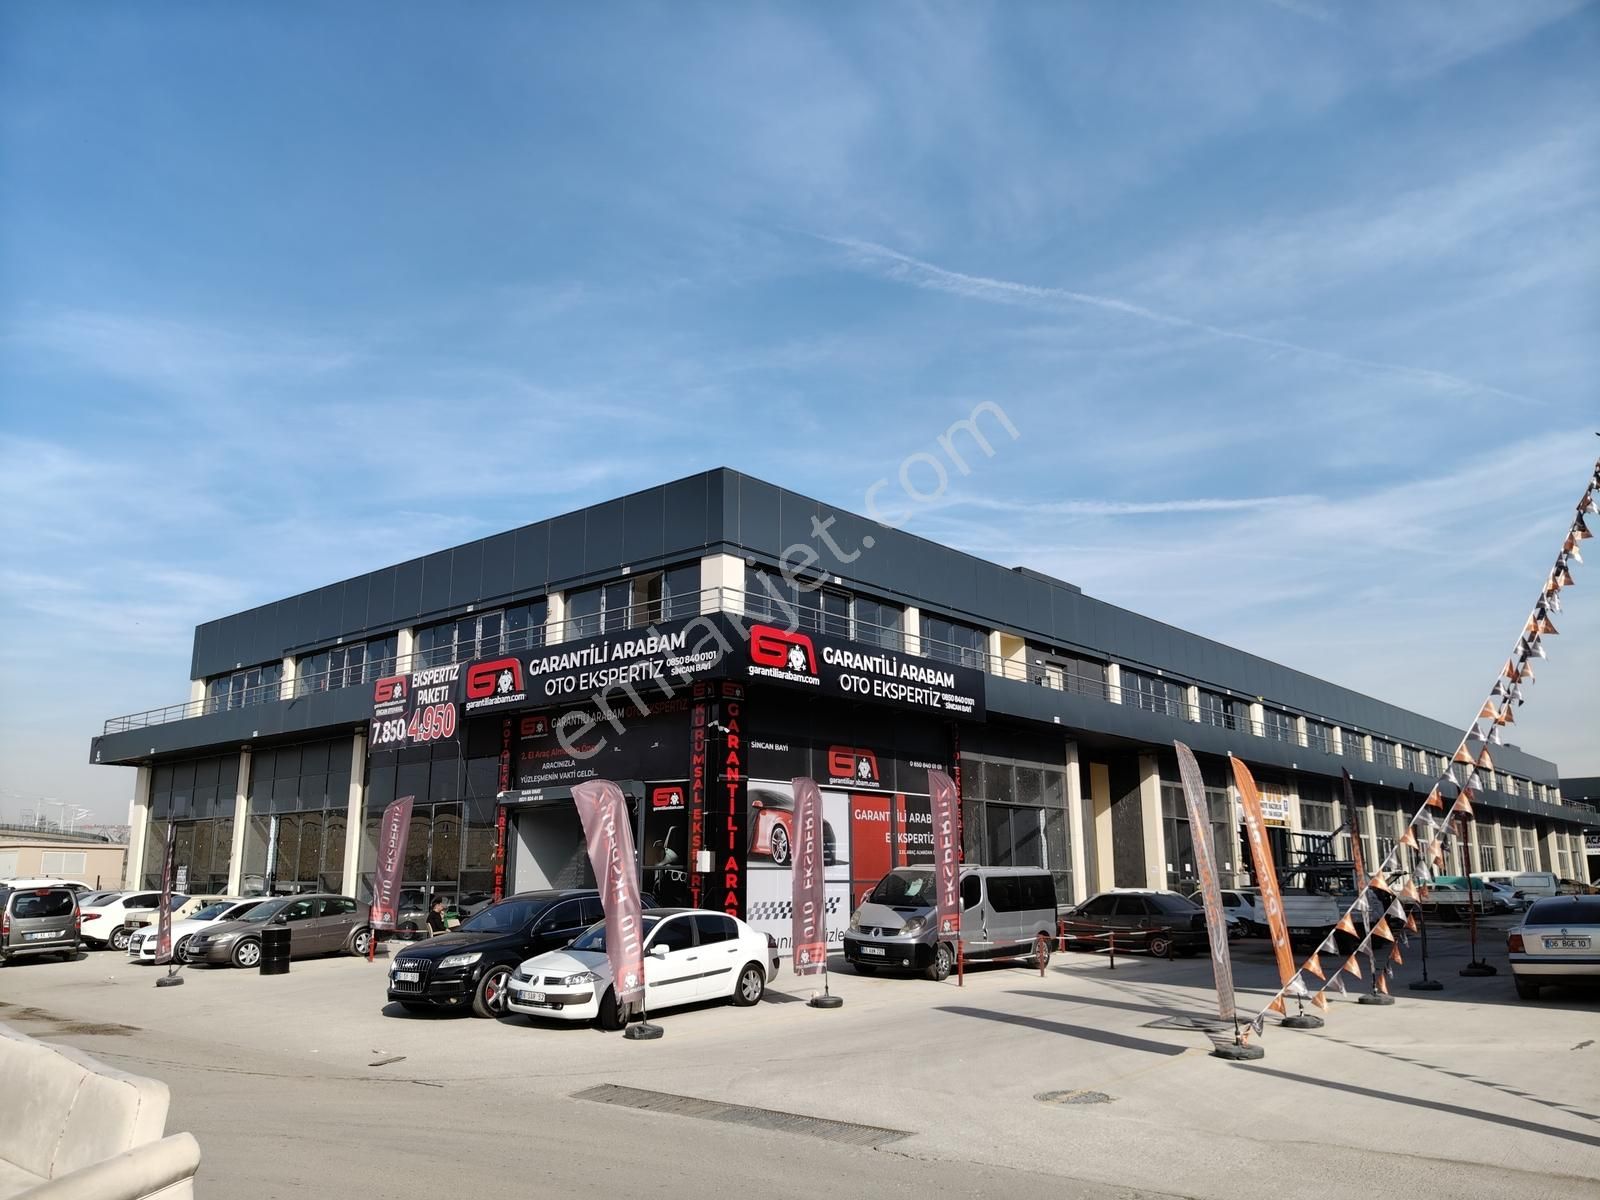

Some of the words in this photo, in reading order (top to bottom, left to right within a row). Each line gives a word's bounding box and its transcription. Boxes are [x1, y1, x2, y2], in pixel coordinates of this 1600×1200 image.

[529, 640, 608, 676] GARANTİLİ
[611, 630, 686, 661] ARABAM
[666, 656, 684, 667] 0850
[684, 653, 700, 664] 840
[700, 650, 717, 661] 0101
[544, 675, 576, 696] OTO
[579, 657, 664, 691] EKSPERTİZ
[671, 664, 695, 676] SİNCAN
[748, 665, 820, 686] garantiliarabam.com
[822, 646, 897, 677] GARANTİLİ
[900, 663, 955, 689] ARABAM
[840, 674, 870, 694] OTO
[873, 680, 941, 708] EKSPERTİZ
[592, 708, 625, 724] ARABAM
[692, 703, 706, 803] KURUMSAL
[751, 740, 774, 751] SİNCAN
[381, 879, 393, 905] OTO
